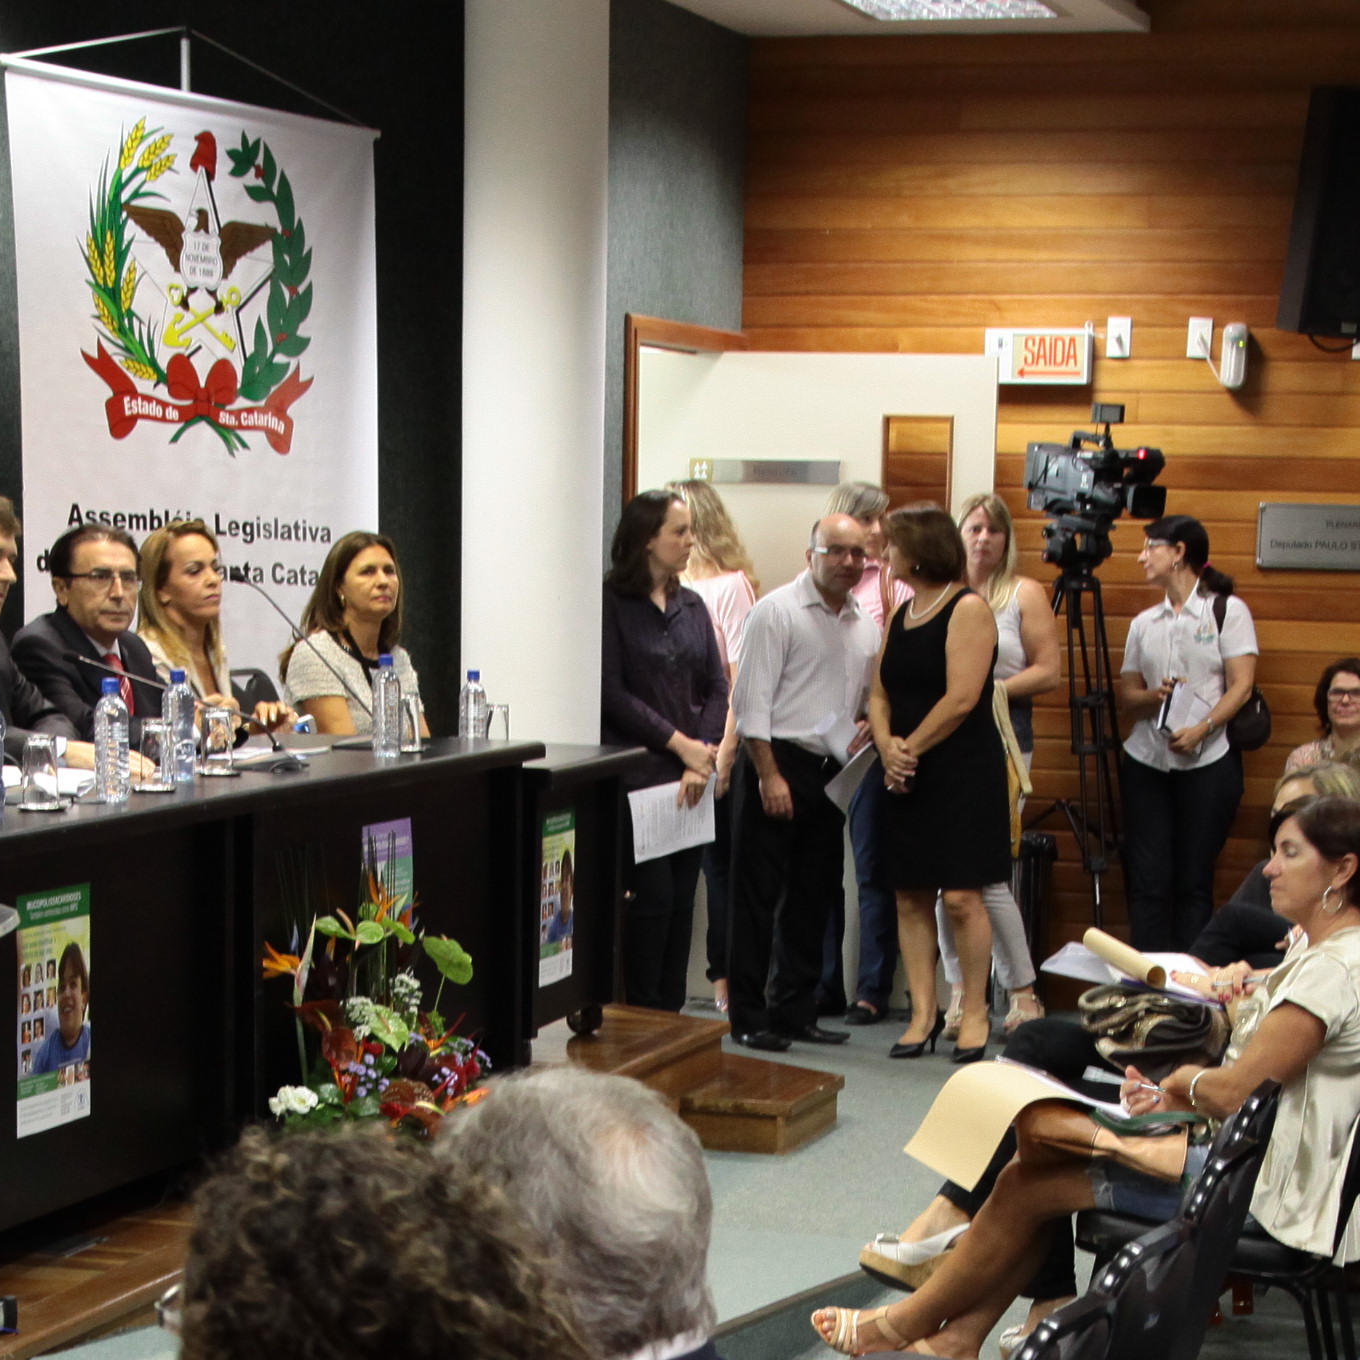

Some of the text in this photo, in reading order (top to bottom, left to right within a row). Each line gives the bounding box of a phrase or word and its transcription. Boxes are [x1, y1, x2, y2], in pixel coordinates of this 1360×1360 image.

[123, 396, 163, 419] Estado
[219, 411, 285, 435] Sta. Catarina
[215, 513, 332, 544] Legislativa
[1270, 539, 1313, 551] Deputado
[1315, 540, 1348, 550] PAULO
